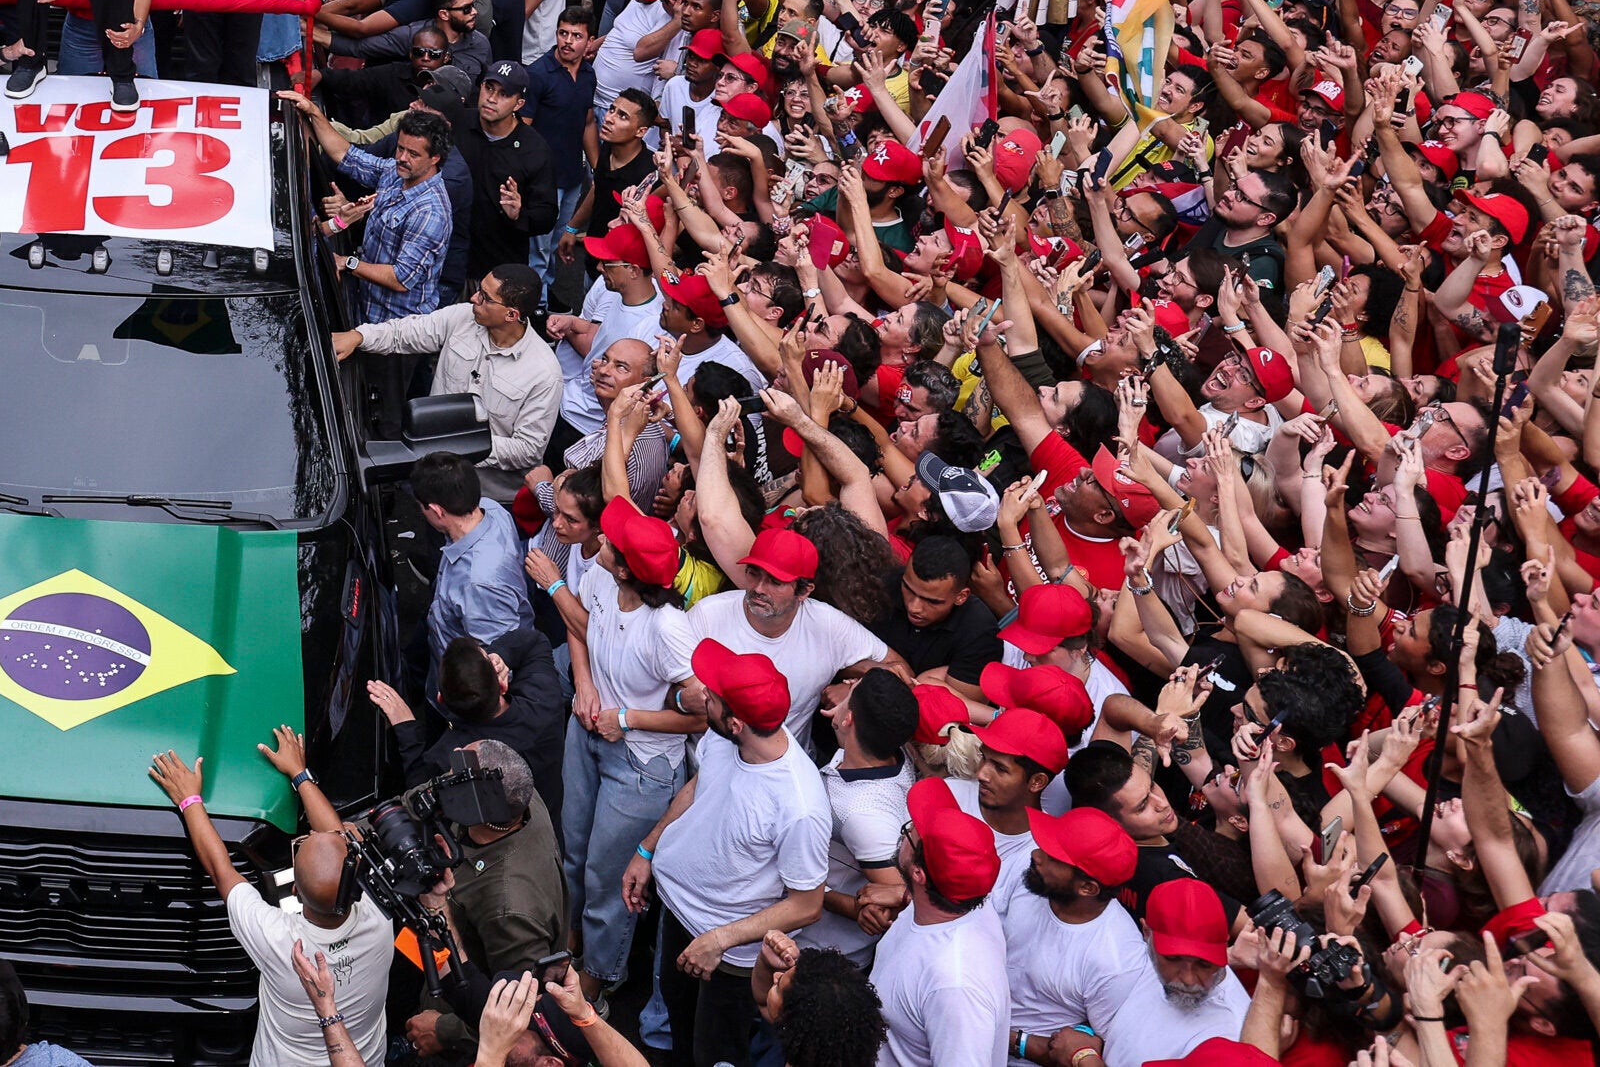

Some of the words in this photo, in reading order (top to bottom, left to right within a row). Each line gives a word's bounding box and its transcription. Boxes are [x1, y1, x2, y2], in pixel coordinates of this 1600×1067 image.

[14, 95, 242, 134] VOTE
[5, 131, 235, 234] 13
[10, 619, 58, 636] ORDEM
[67, 627, 144, 662] PROGRESSO
